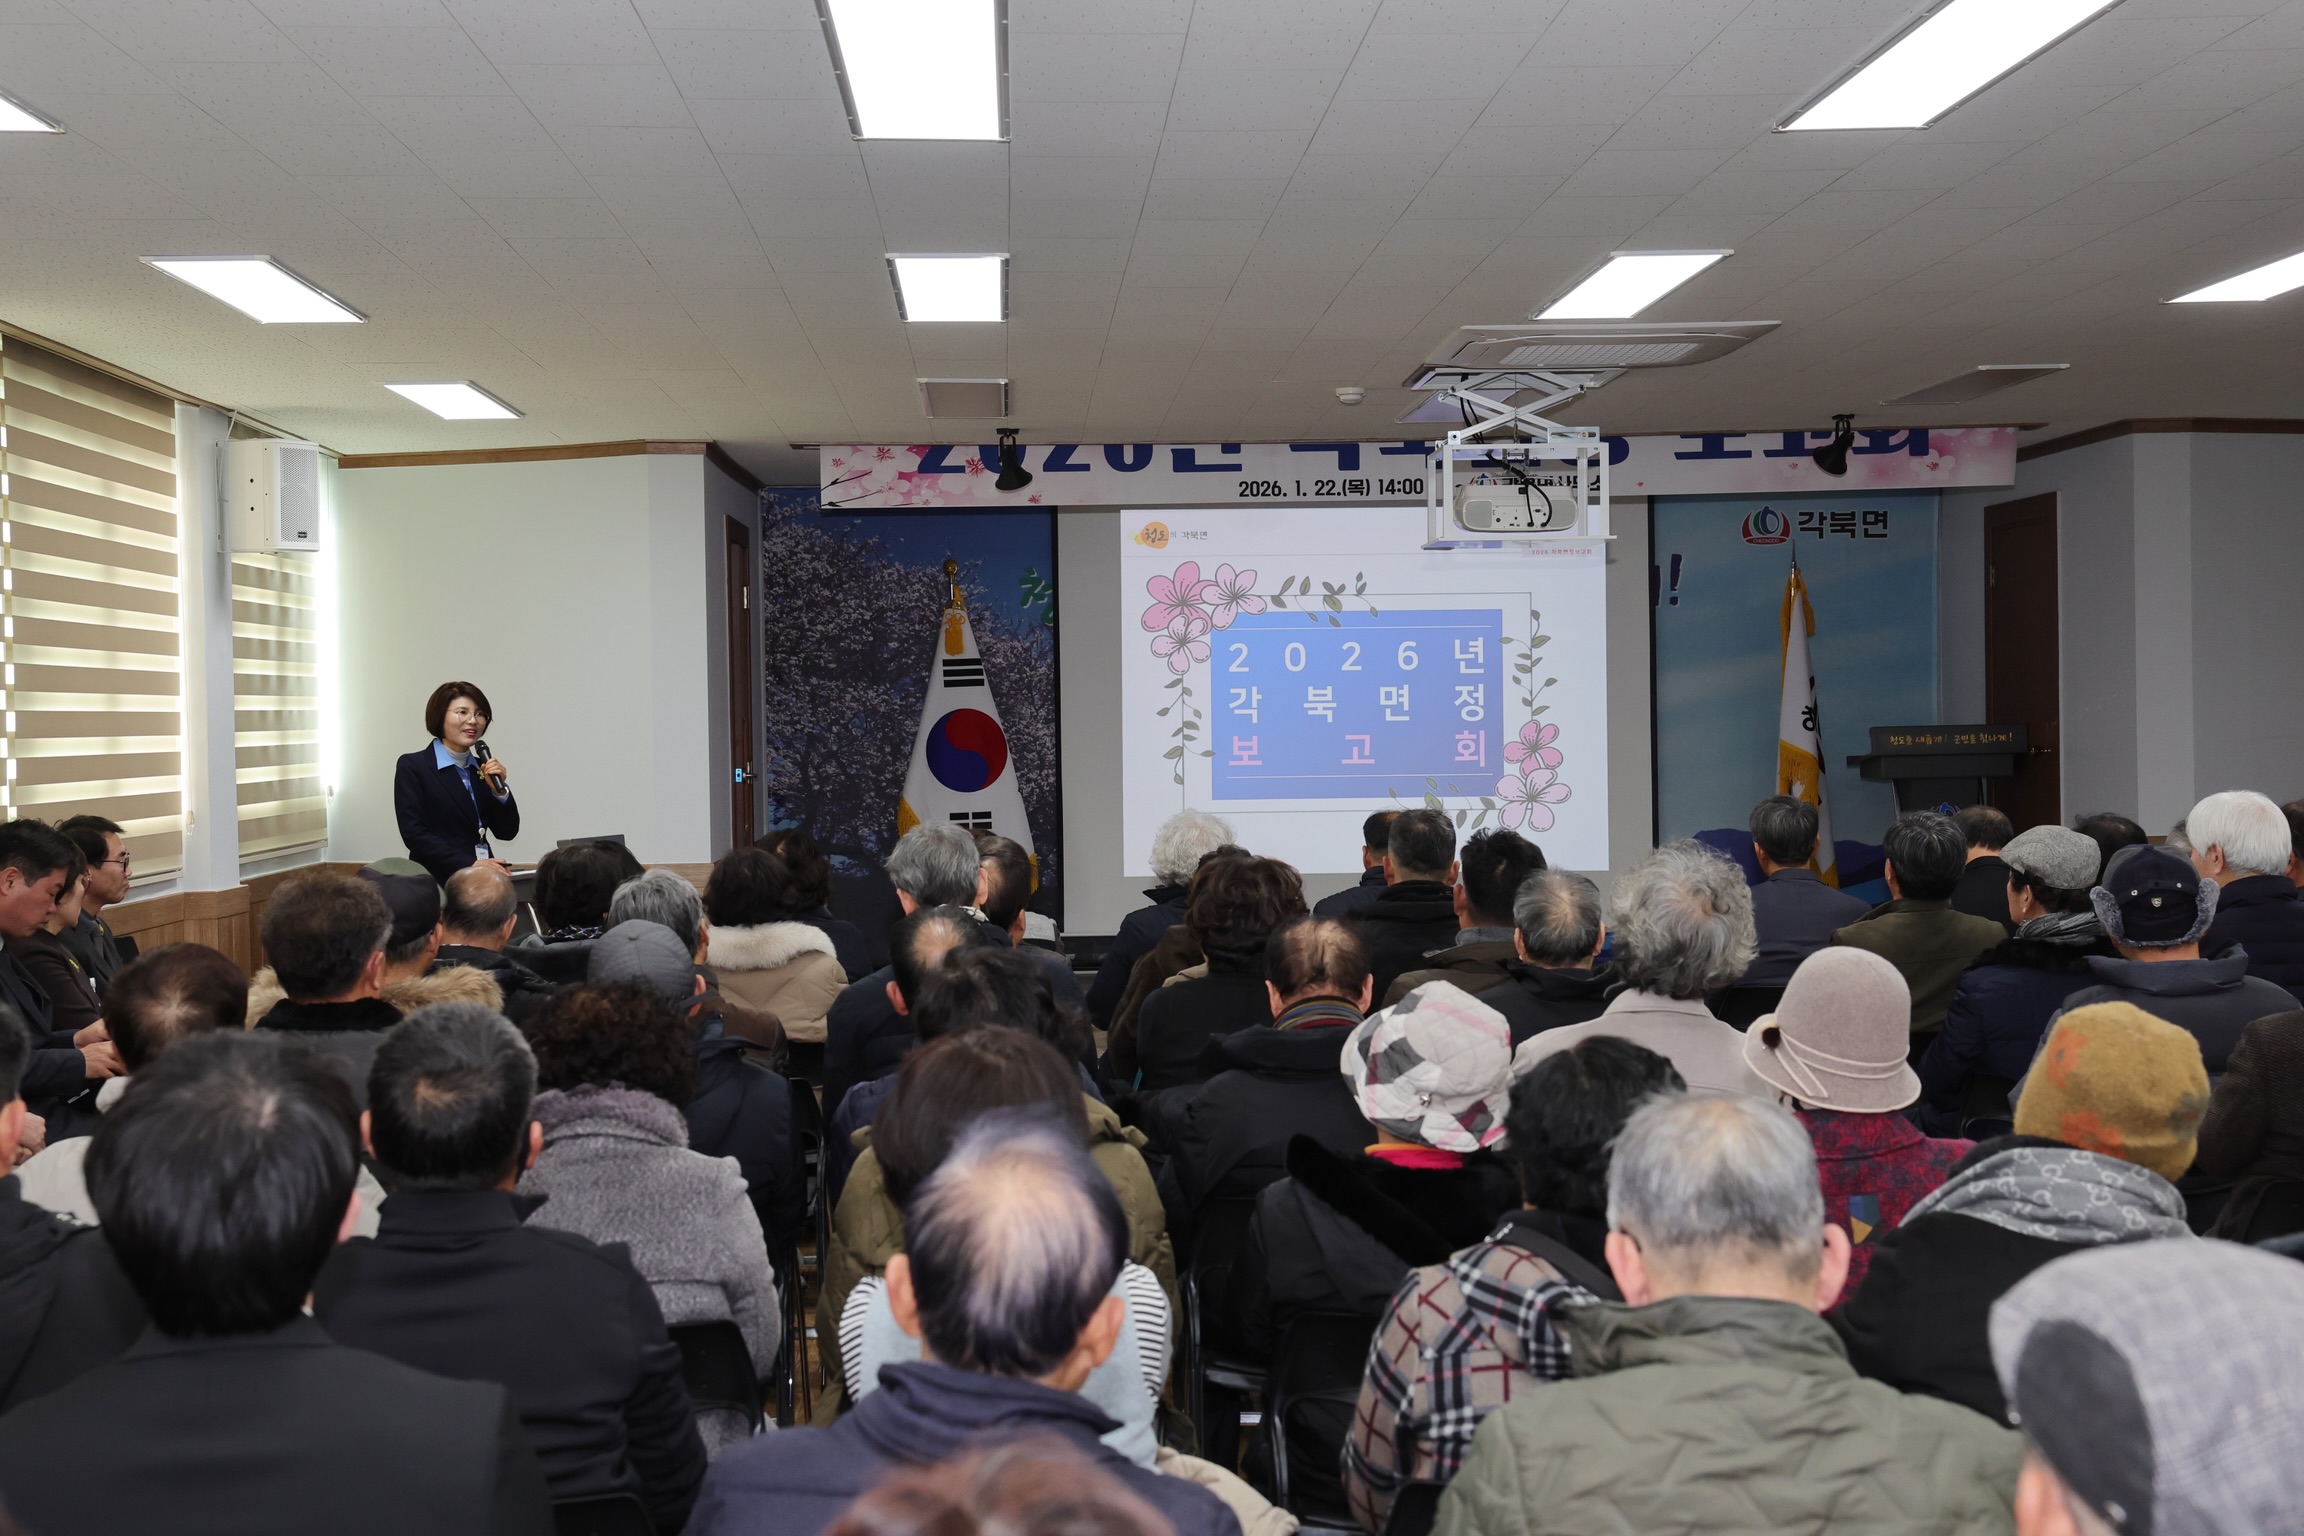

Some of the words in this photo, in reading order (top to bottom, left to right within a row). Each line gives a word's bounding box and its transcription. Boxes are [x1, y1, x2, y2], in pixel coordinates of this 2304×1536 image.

[1238, 480, 1288, 498] 2026.
[1295, 480, 1307, 497] 1.
[1314, 478, 1371, 497] 22.(목)
[1378, 478, 1424, 495] 14:00
[1798, 510, 1888, 540] 각북면
[1181, 530, 1208, 541] 각북면
[1889, 734, 1913, 746] 청도를
[1953, 733, 1977, 745] 군민을
